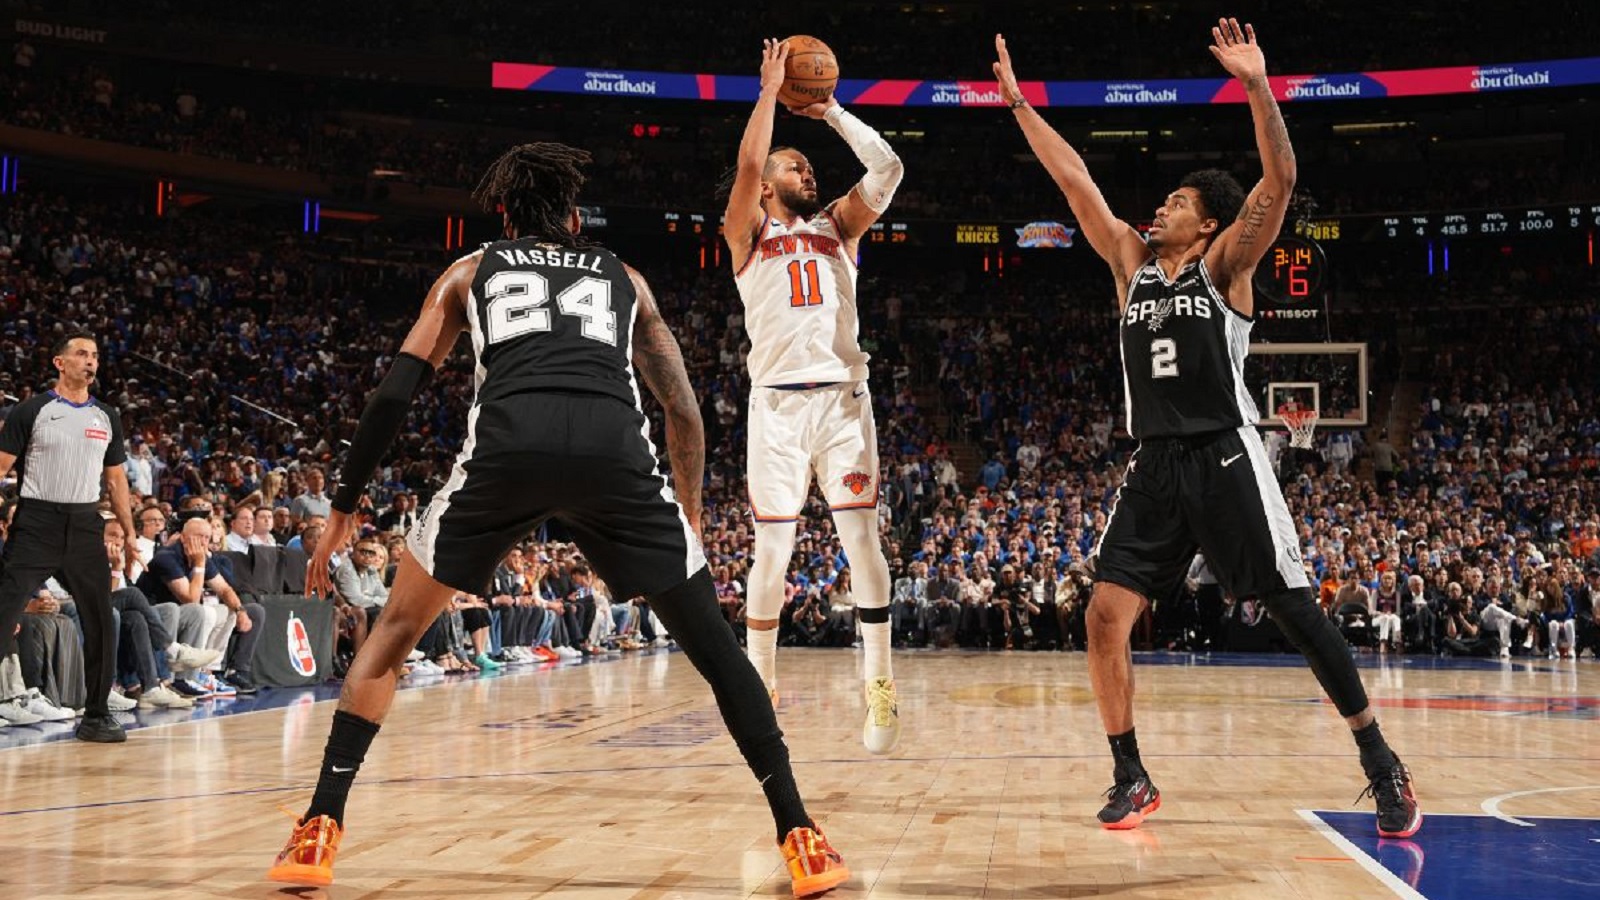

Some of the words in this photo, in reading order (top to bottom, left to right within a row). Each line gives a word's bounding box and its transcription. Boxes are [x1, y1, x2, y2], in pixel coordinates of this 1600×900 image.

[15, 18, 53, 36] BUD
[55, 23, 108, 43] LIGHT
[583, 79, 612, 91] abu
[614, 80, 656, 94] dhabi
[1470, 76, 1501, 89] abu
[1503, 71, 1549, 87] dhabi
[932, 90, 960, 103] abu
[1105, 91, 1133, 103] abu
[1135, 89, 1177, 103] dhabi
[1285, 85, 1314, 98] abu
[1316, 82, 1360, 96] dhabi
[1440, 223, 1468, 235] 45.5
[1480, 221, 1508, 233] 51.7
[1519, 218, 1554, 231] 100.0
[1570, 217, 1579, 228] 5
[956, 231, 1000, 244] KNICKS
[1388, 227, 1397, 237] 3
[1415, 226, 1425, 236] 4
[760, 234, 798, 262] NEW
[797, 234, 841, 261] YORK
[496, 249, 603, 274] VASSELL
[1274, 248, 1312, 266] 3:14
[787, 260, 823, 308] 11
[1289, 266, 1309, 296] 6
[484, 271, 617, 347] 24
[1126, 294, 1212, 327] SPURS
[1276, 309, 1319, 319] TISSOT
[1150, 337, 1180, 379] 2
